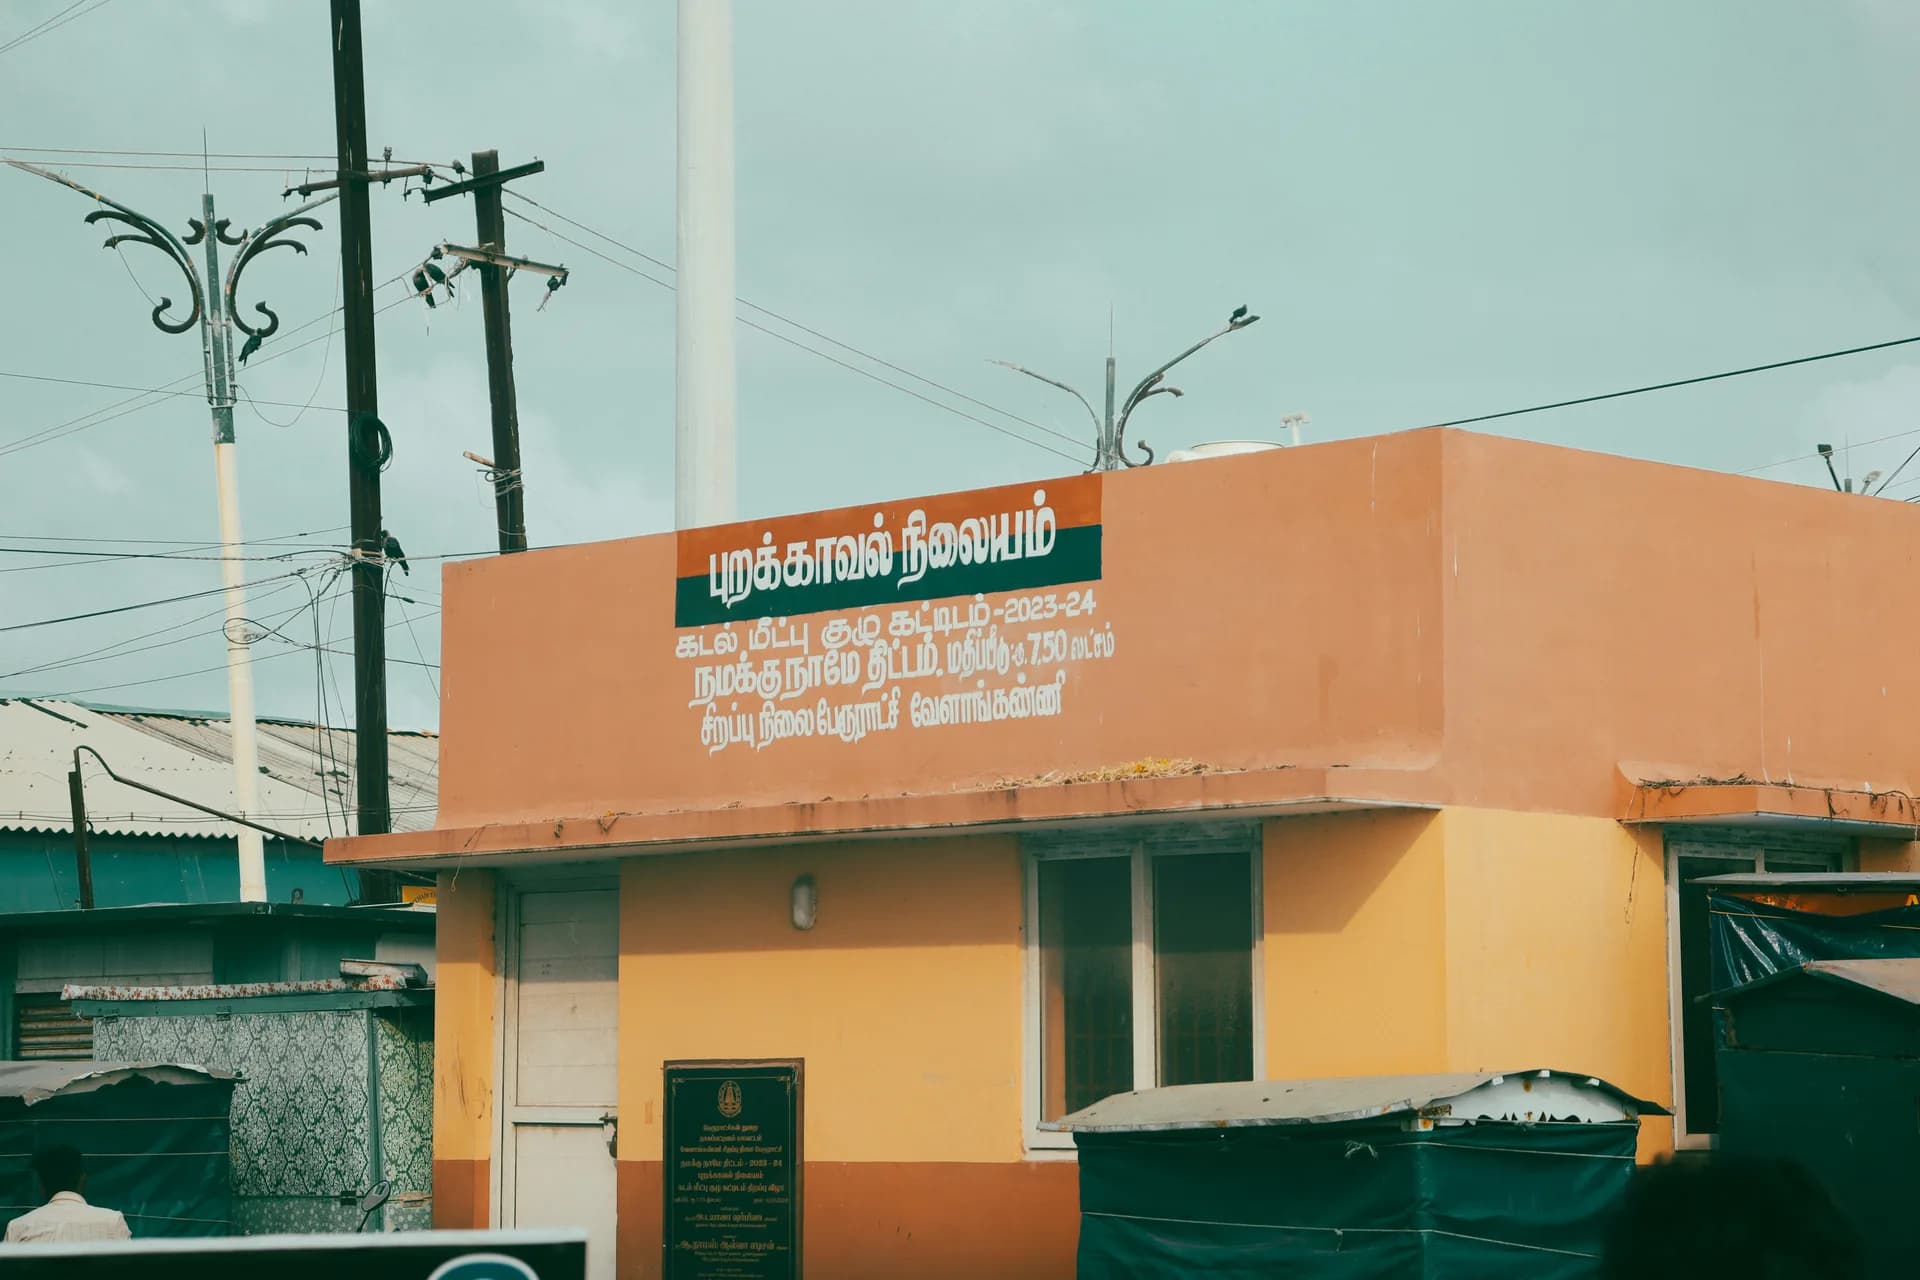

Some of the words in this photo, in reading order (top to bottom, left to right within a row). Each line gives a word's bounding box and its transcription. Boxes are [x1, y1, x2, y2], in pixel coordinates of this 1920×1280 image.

[709, 511, 894, 609] புறக்காவல்
[897, 489, 1056, 590] நிலையம்
[675, 621, 739, 658] கடல்
[749, 616, 809, 655] மீட்பு
[821, 613, 881, 649] குழு
[701, 701, 755, 758] சிறப்பு
[910, 669, 1066, 728] வேளாங்கண்ணி
